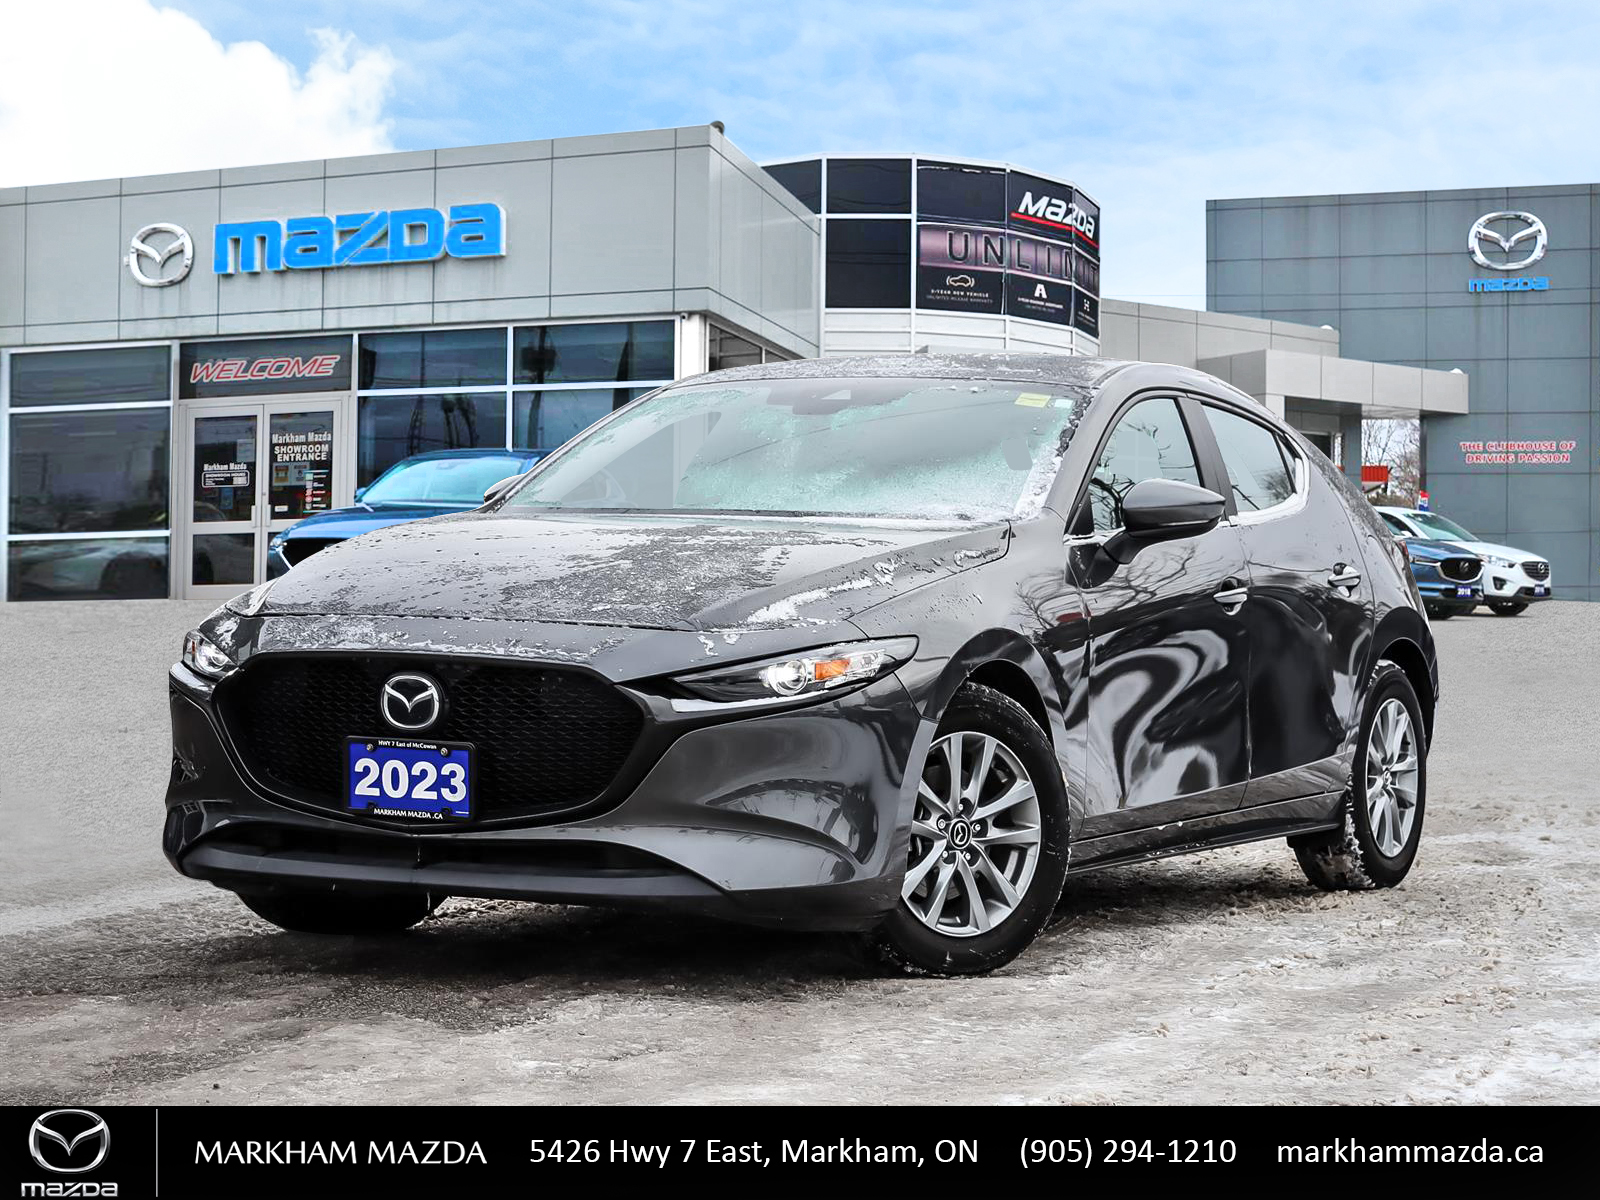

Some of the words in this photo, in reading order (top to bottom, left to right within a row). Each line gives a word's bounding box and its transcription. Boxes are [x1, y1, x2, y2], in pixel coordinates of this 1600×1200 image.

[190, 355, 340, 383] WELCOME
[272, 433, 306, 444] Markham
[307, 431, 332, 442] Mazda
[274, 444, 328, 455] SHOWROOM
[1460, 442, 1483, 452] THE
[1486, 441, 1556, 452] CLUBHOUSE
[1559, 440, 1576, 451] OF
[277, 452, 327, 462] ENTRANCE
[1465, 453, 1515, 464] DRIVING
[1518, 453, 1571, 463] PASSION
[378, 739, 391, 747] HWY
[412, 742, 437, 750] McCowan
[354, 757, 467, 802] 2023
[373, 808, 407, 817] MARKHAM
[407, 810, 432, 819] MAZDA
